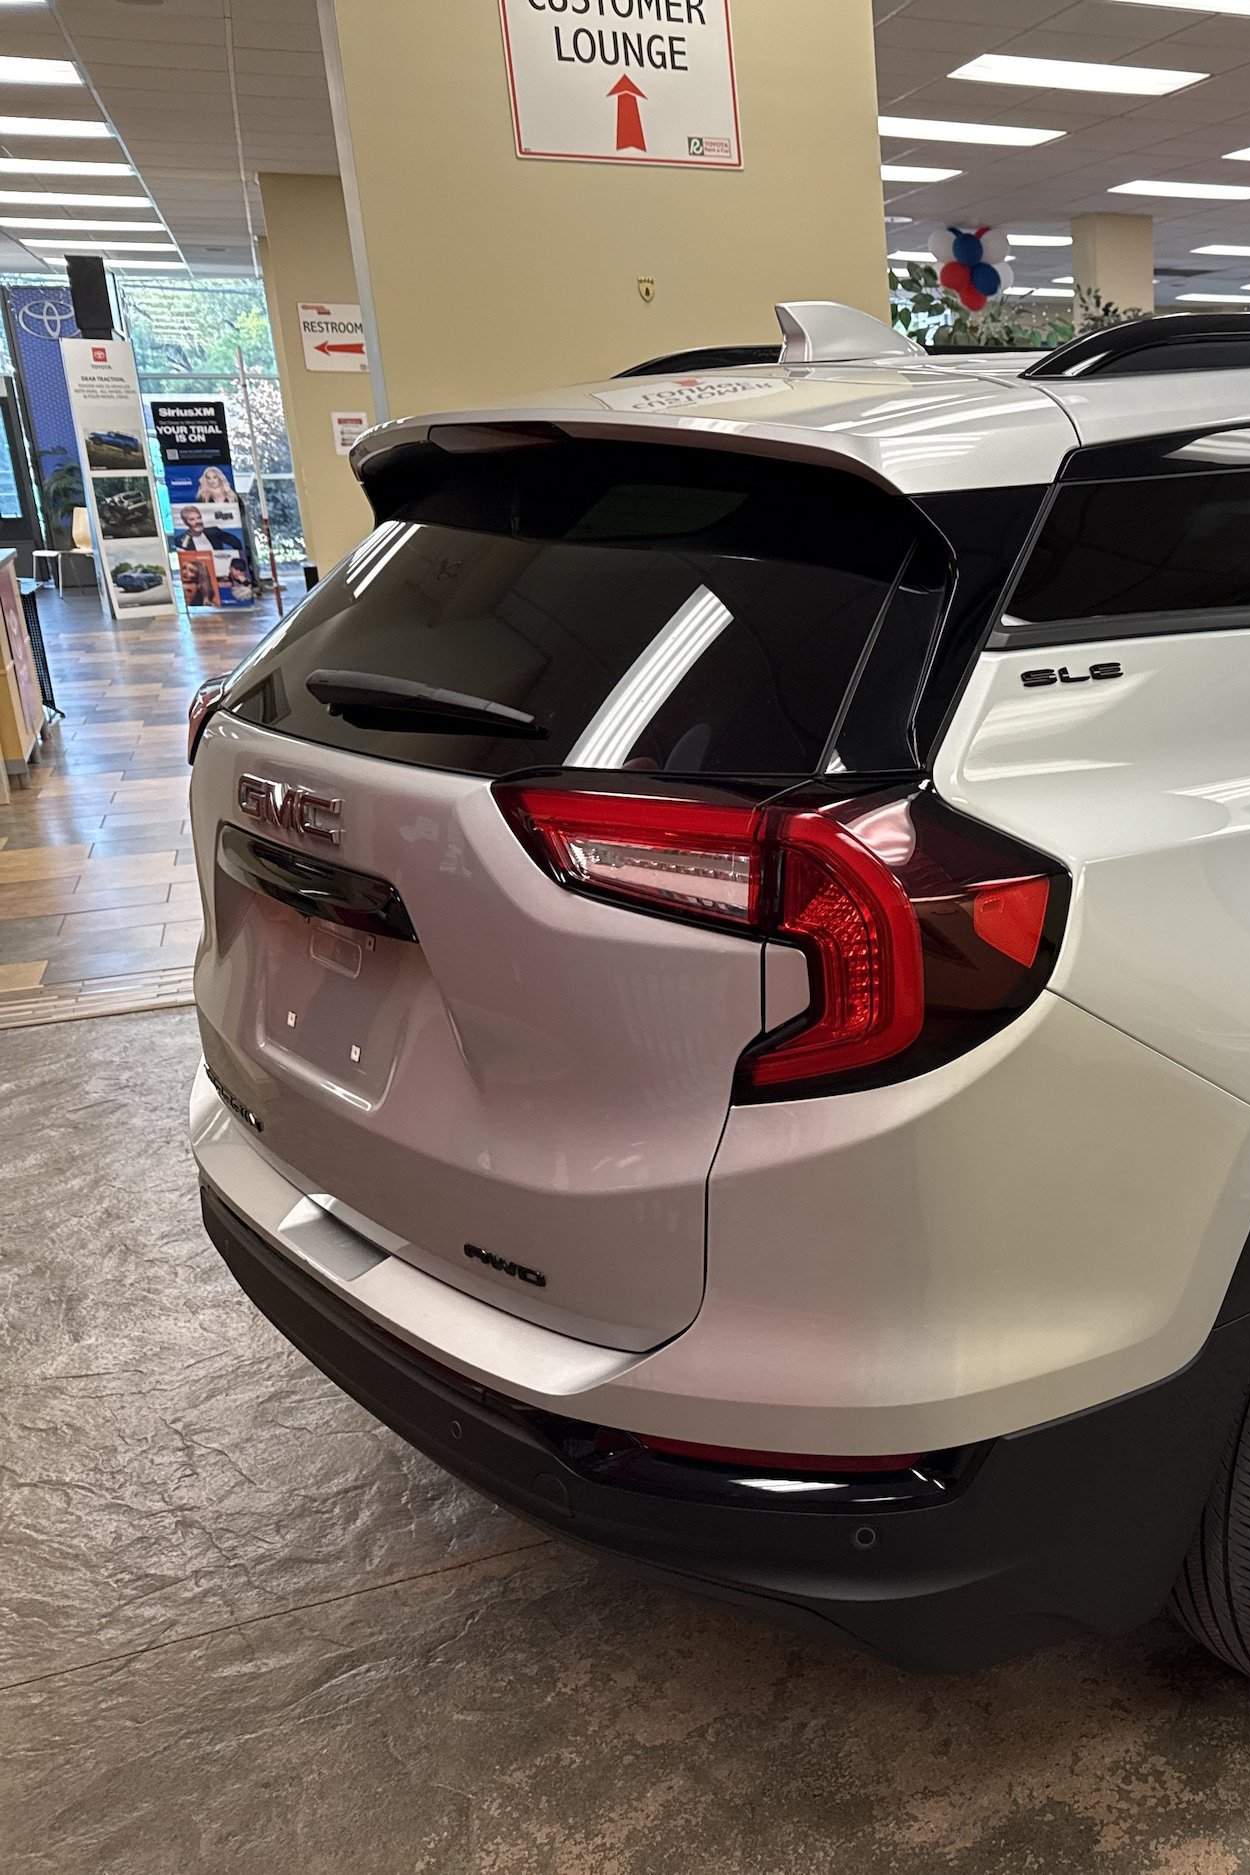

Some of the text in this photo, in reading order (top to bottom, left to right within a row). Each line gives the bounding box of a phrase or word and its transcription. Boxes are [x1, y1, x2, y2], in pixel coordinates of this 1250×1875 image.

[554, 26, 688, 71] LOUNGE
[303, 321, 364, 334] RESTROOM
[158, 407, 216, 417] SiriusXM
[156, 424, 222, 435] YOUR TRIAL
[175, 433, 206, 443] IS ON
[1021, 662, 1124, 688] SLE
[238, 773, 341, 845] GMC
[463, 1243, 546, 1287] AWD
